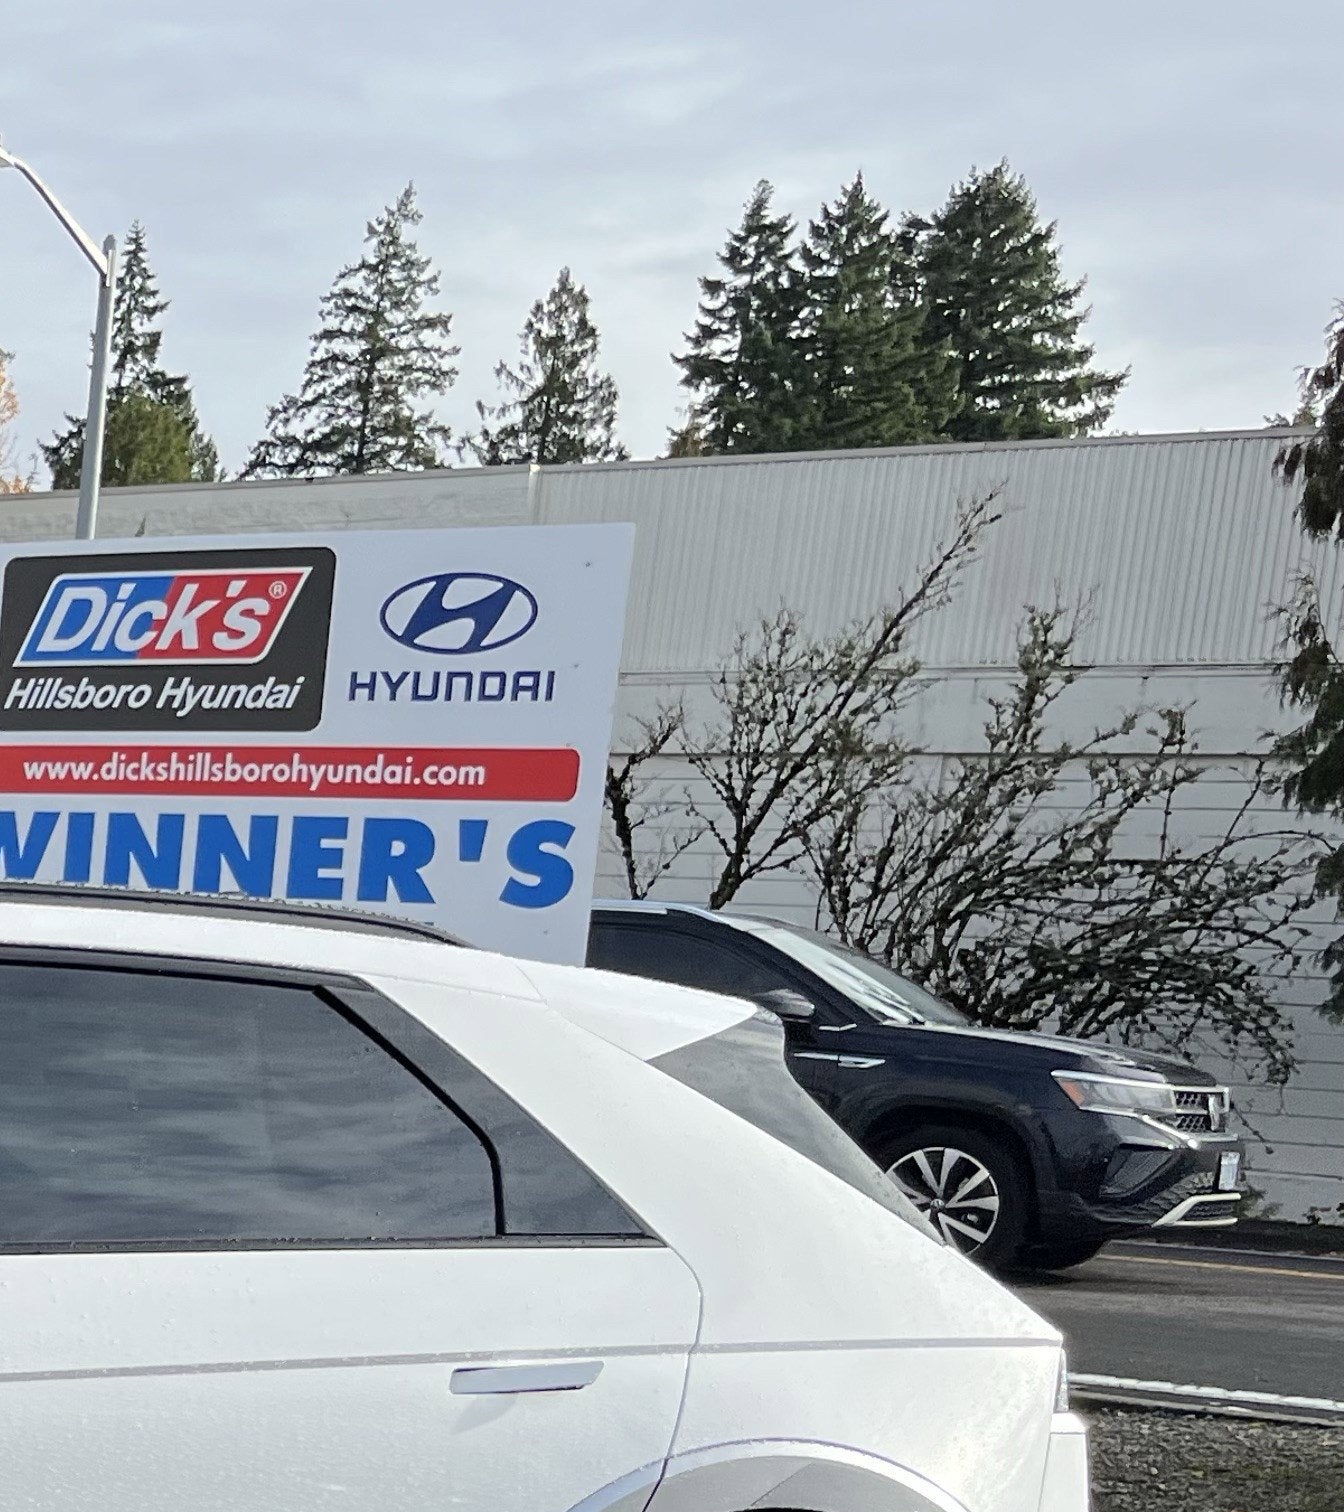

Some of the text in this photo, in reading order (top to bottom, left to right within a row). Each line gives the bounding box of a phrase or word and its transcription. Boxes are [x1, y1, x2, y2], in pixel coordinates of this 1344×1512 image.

[4, 676, 305, 717] Hillsboro Hyundai
[349, 671, 555, 701] HYUNDAI
[23, 747, 487, 791] www.dickshillsborohyundai.com
